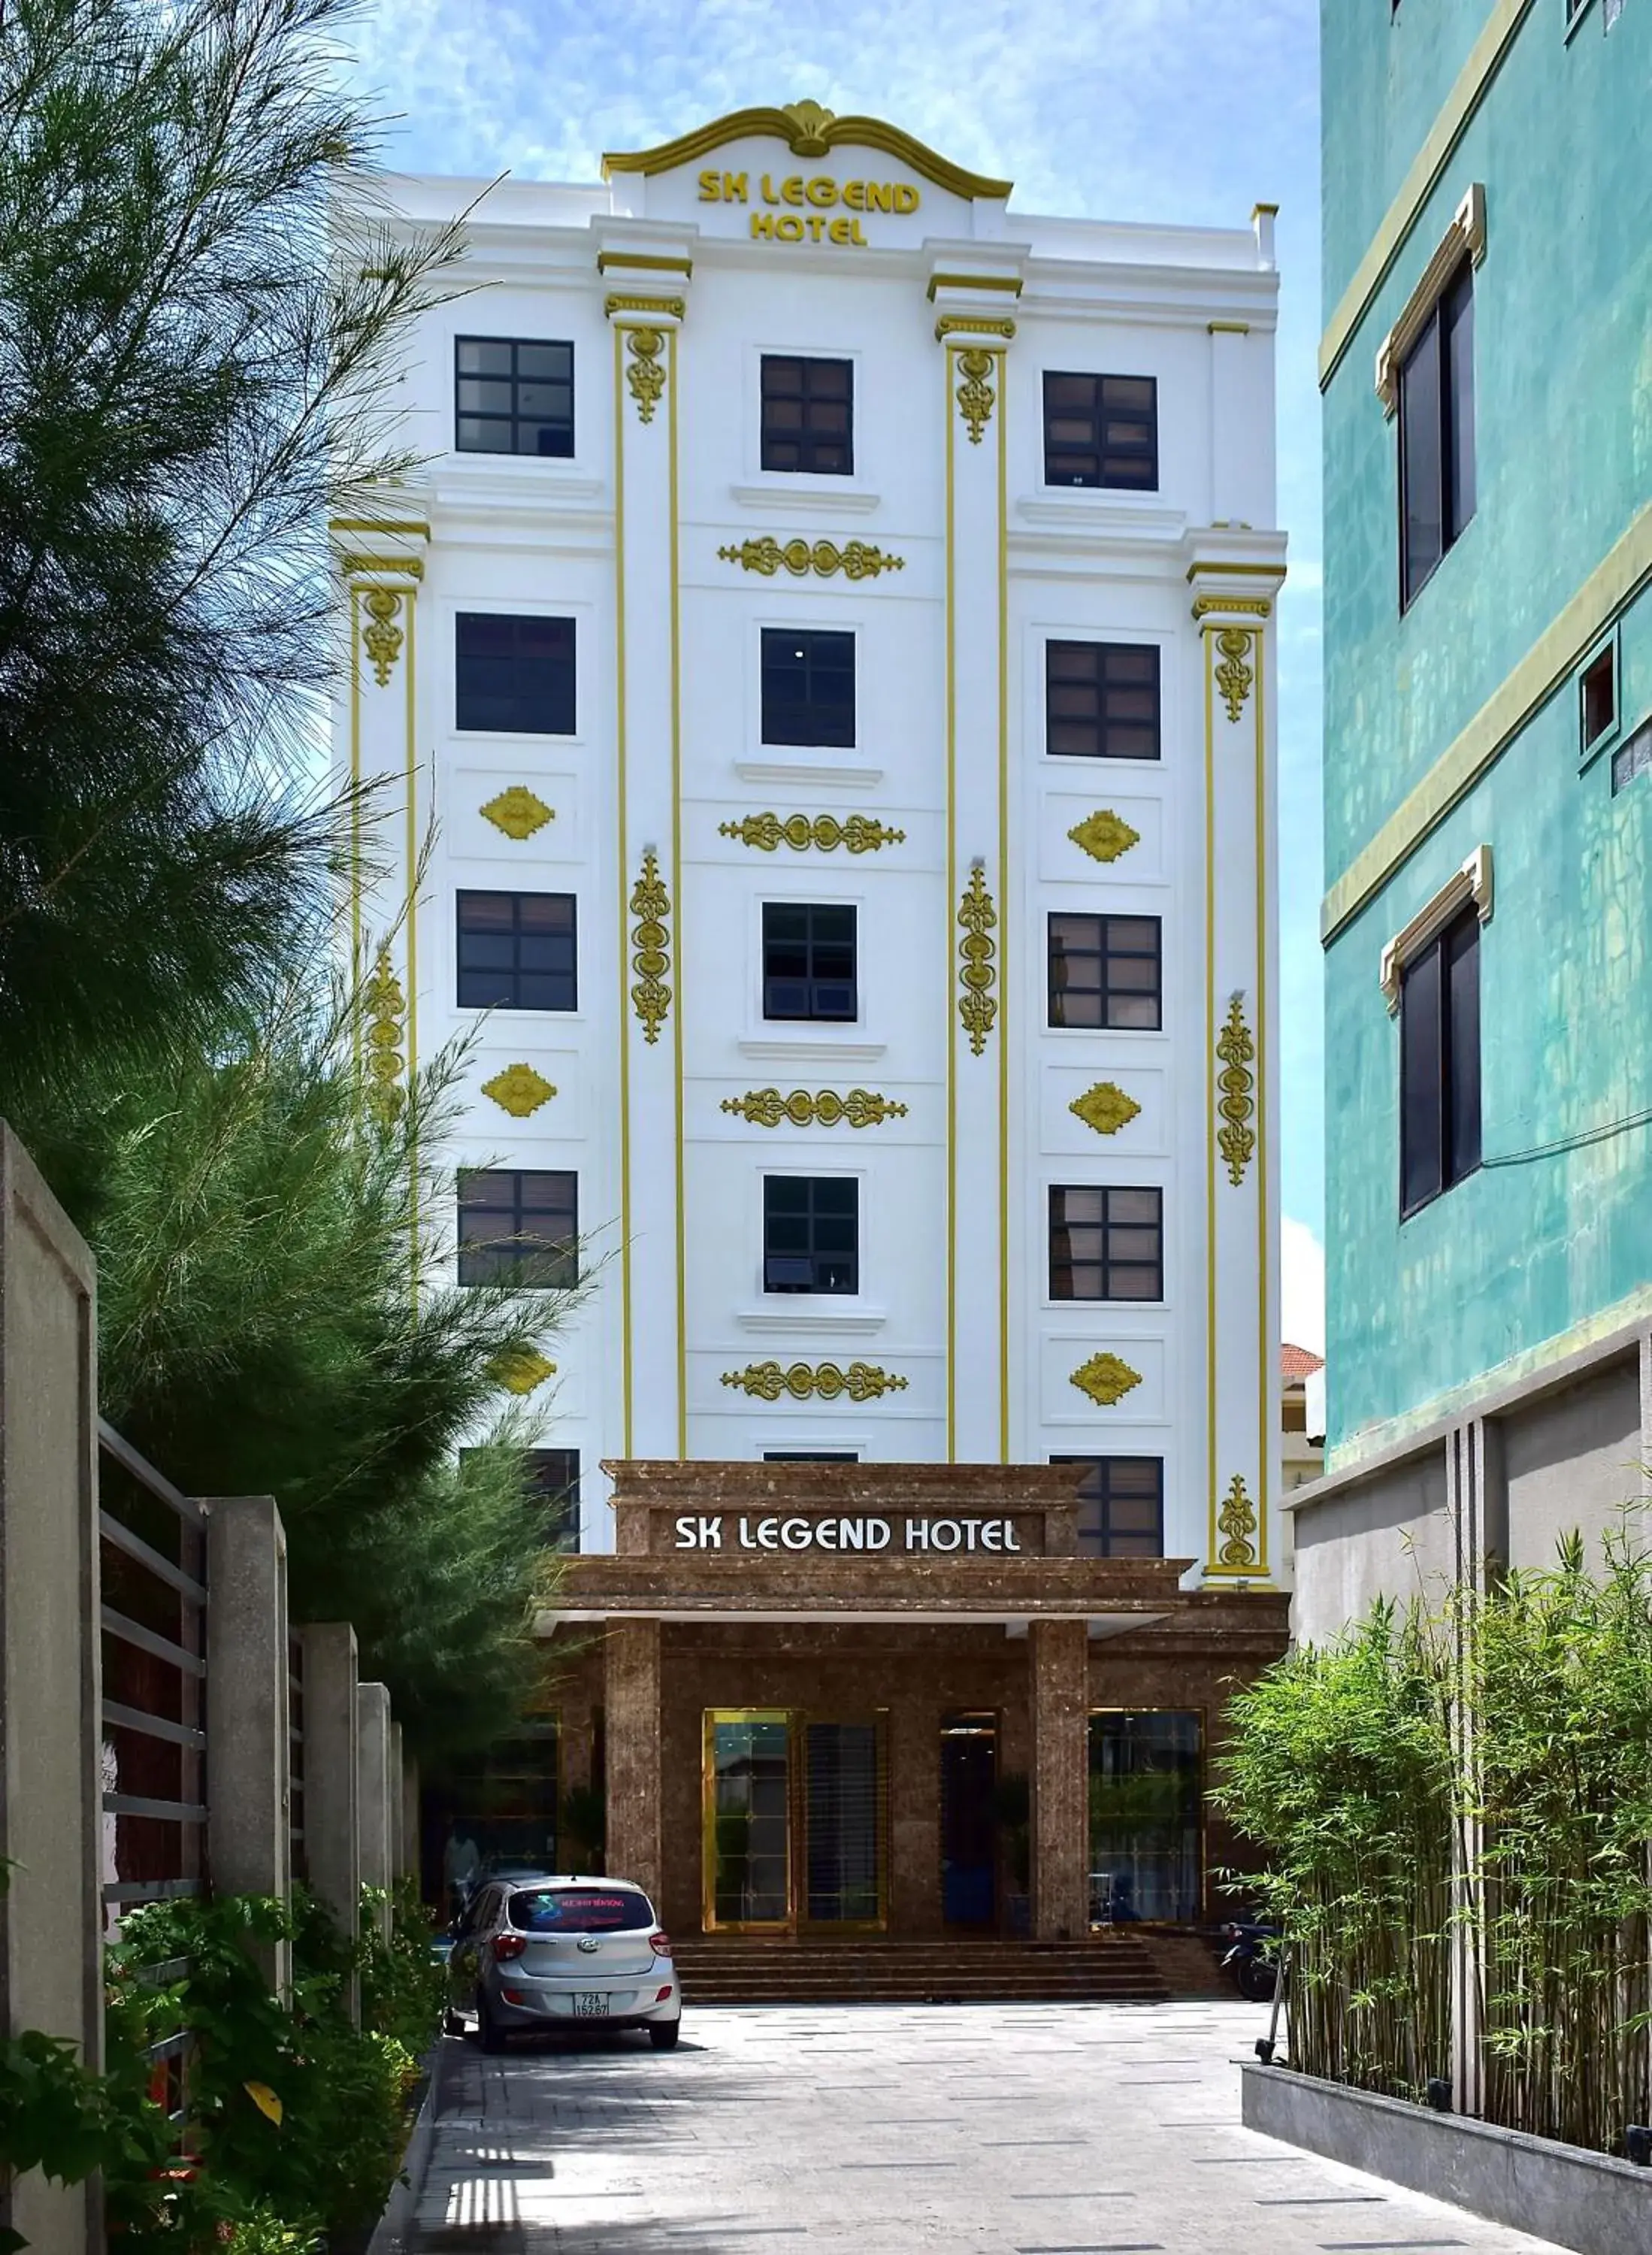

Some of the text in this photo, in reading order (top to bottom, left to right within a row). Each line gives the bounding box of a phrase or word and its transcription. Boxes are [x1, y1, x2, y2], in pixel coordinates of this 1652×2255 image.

[698, 171, 920, 214] SK LEGEND
[750, 213, 867, 246] HOTEL
[675, 1517, 1021, 1551] SK LEGEND HOTEL
